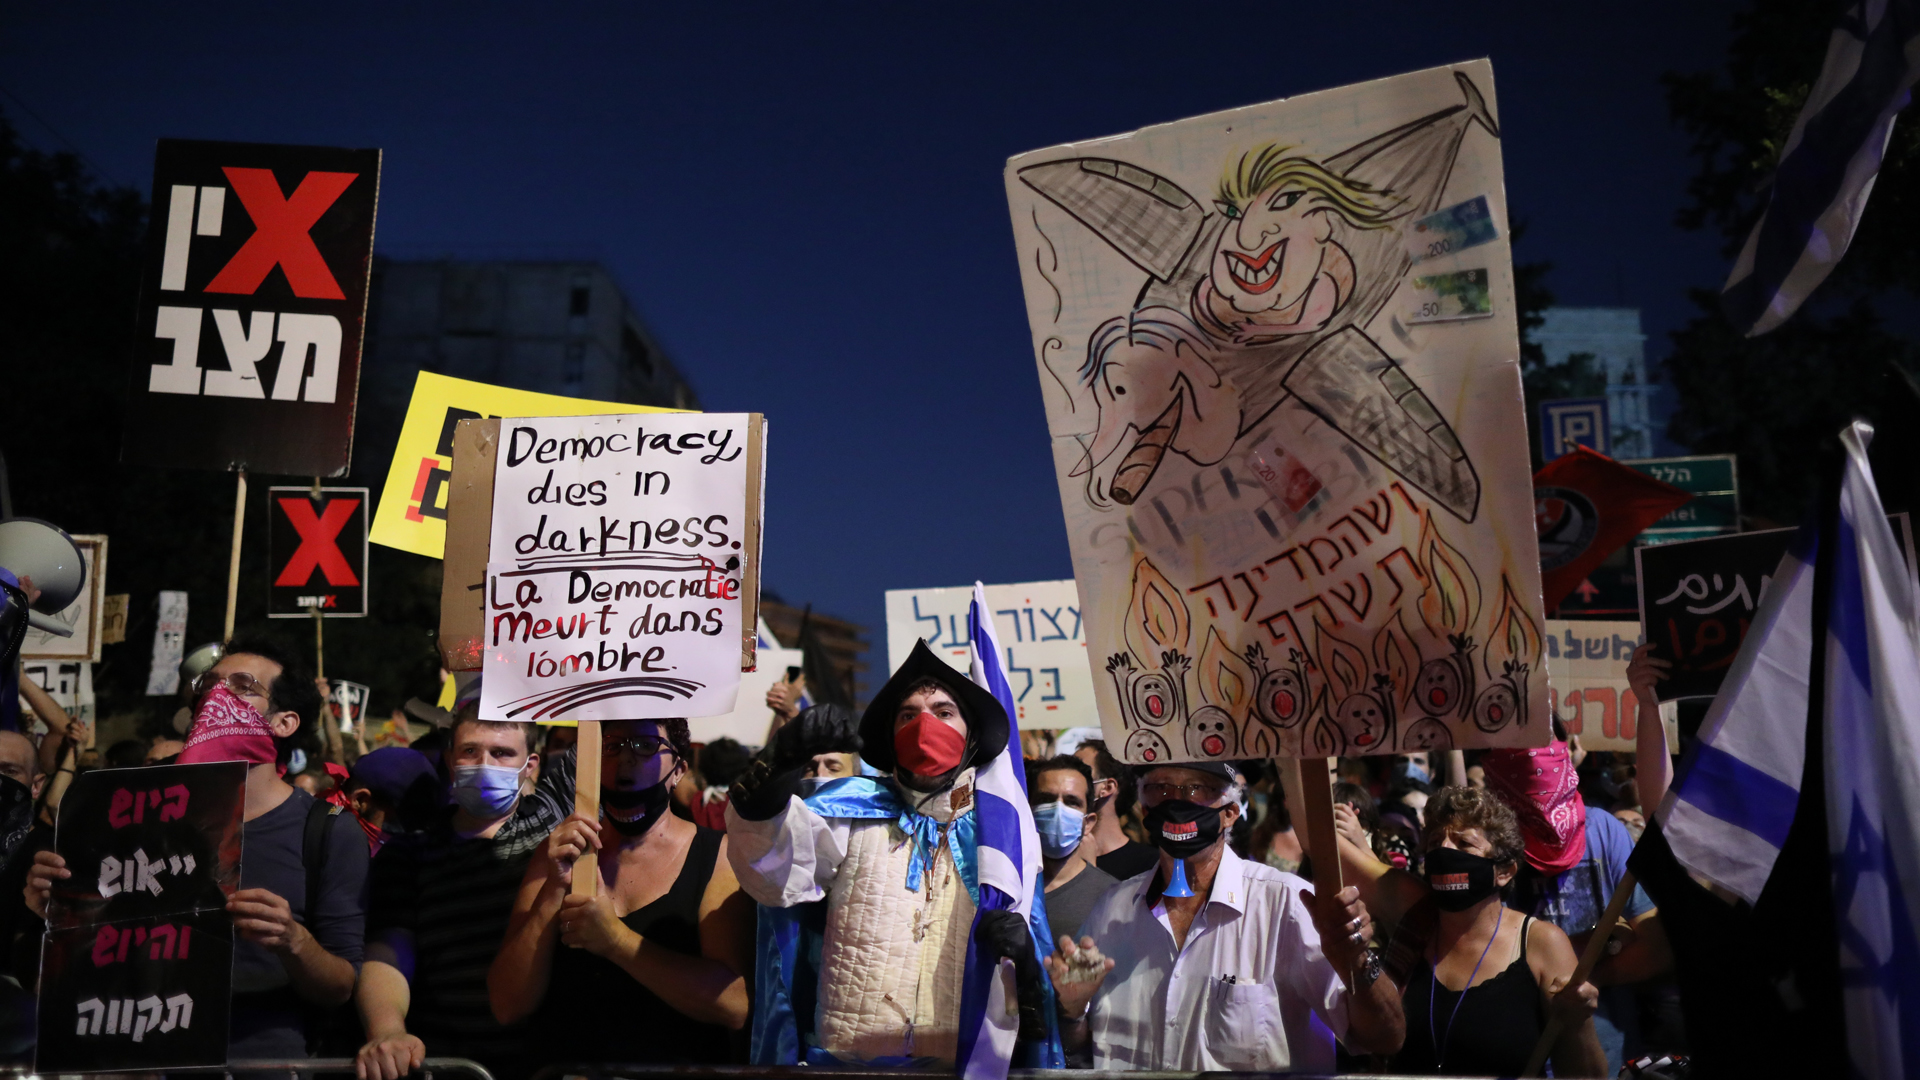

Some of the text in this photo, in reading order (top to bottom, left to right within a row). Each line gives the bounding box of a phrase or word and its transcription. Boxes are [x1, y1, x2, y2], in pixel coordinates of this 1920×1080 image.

[1427, 238, 1451, 258] 200
[1422, 302, 1439, 317] 50
[148, 305, 343, 404] מצב
[506, 426, 742, 466] Democracy
[527, 469, 670, 505] dies in
[1258, 464, 1276, 482] 20
[515, 514, 742, 556] darkness.
[490, 575, 543, 610] La
[628, 604, 724, 638] dans
[1162, 820, 1198, 834] CRIME
[1162, 830, 1198, 842] MINISTER
[75, 991, 194, 1043] תקווה
